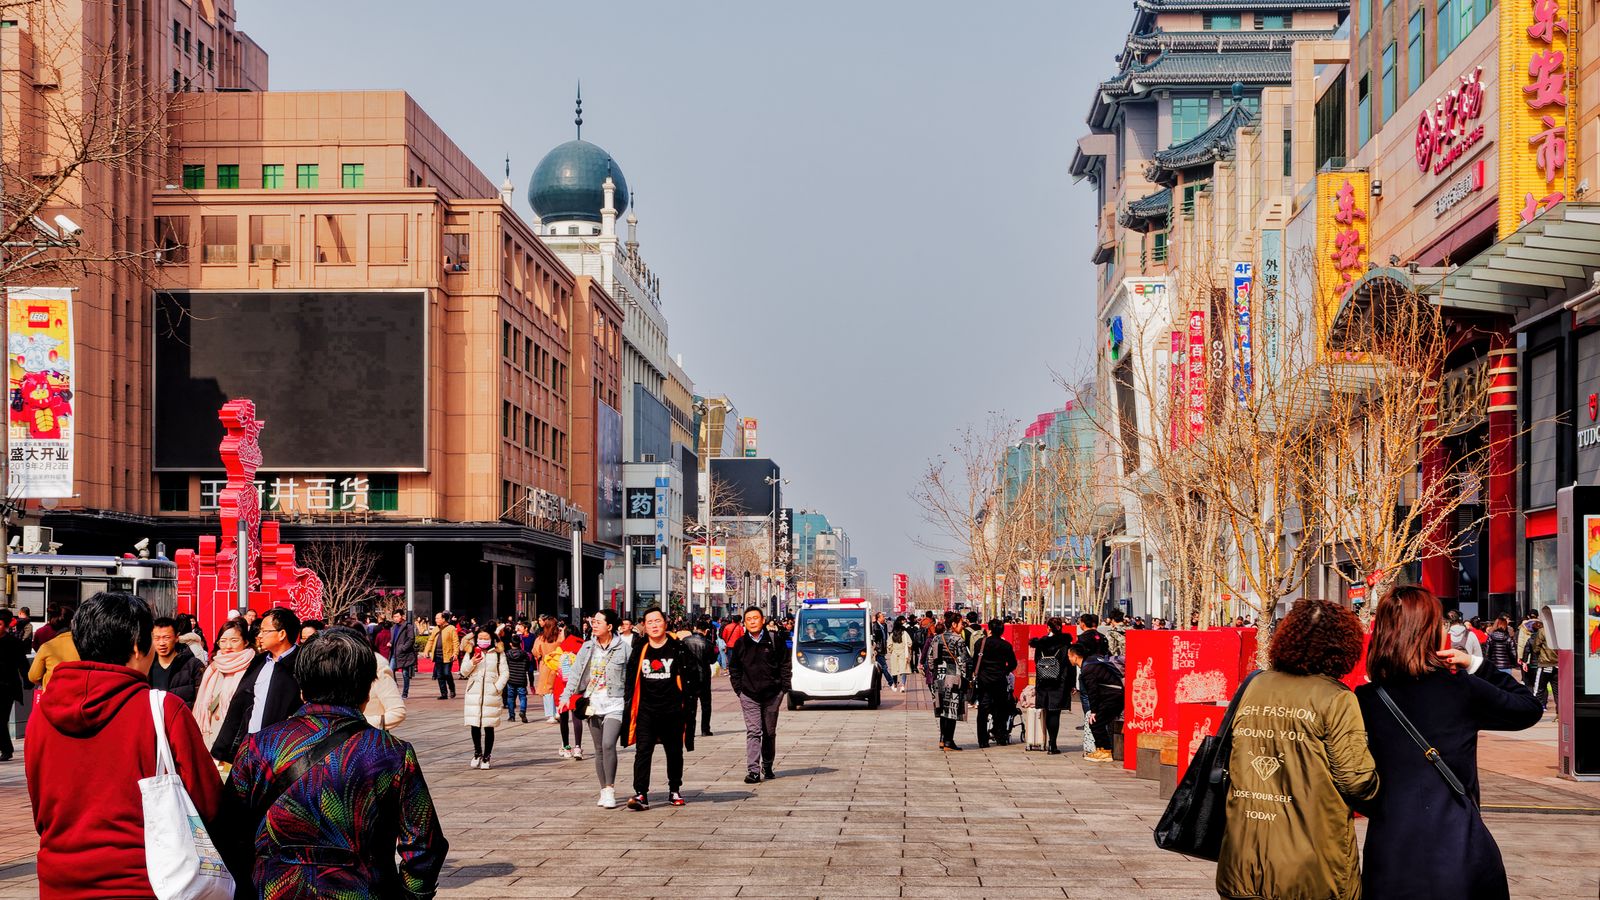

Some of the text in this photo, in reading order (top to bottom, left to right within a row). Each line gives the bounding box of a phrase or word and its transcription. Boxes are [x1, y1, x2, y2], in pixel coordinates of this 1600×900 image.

[1520, 0, 1568, 224] 东安市
[1235, 263, 1251, 274] 4F
[1135, 284, 1166, 297] apm
[1212, 340, 1223, 378] ecco
[10, 447, 69, 461] 盛大开业
[10, 462, 69, 471] 2019年2月22日
[200, 477, 370, 511] 王井百货
[630, 492, 653, 515] 药
[1262, 706, 1317, 723] FASHION
[1280, 730, 1305, 742] YOU
[1233, 789, 1250, 799] LOSE
[1245, 810, 1277, 821] TODAY
